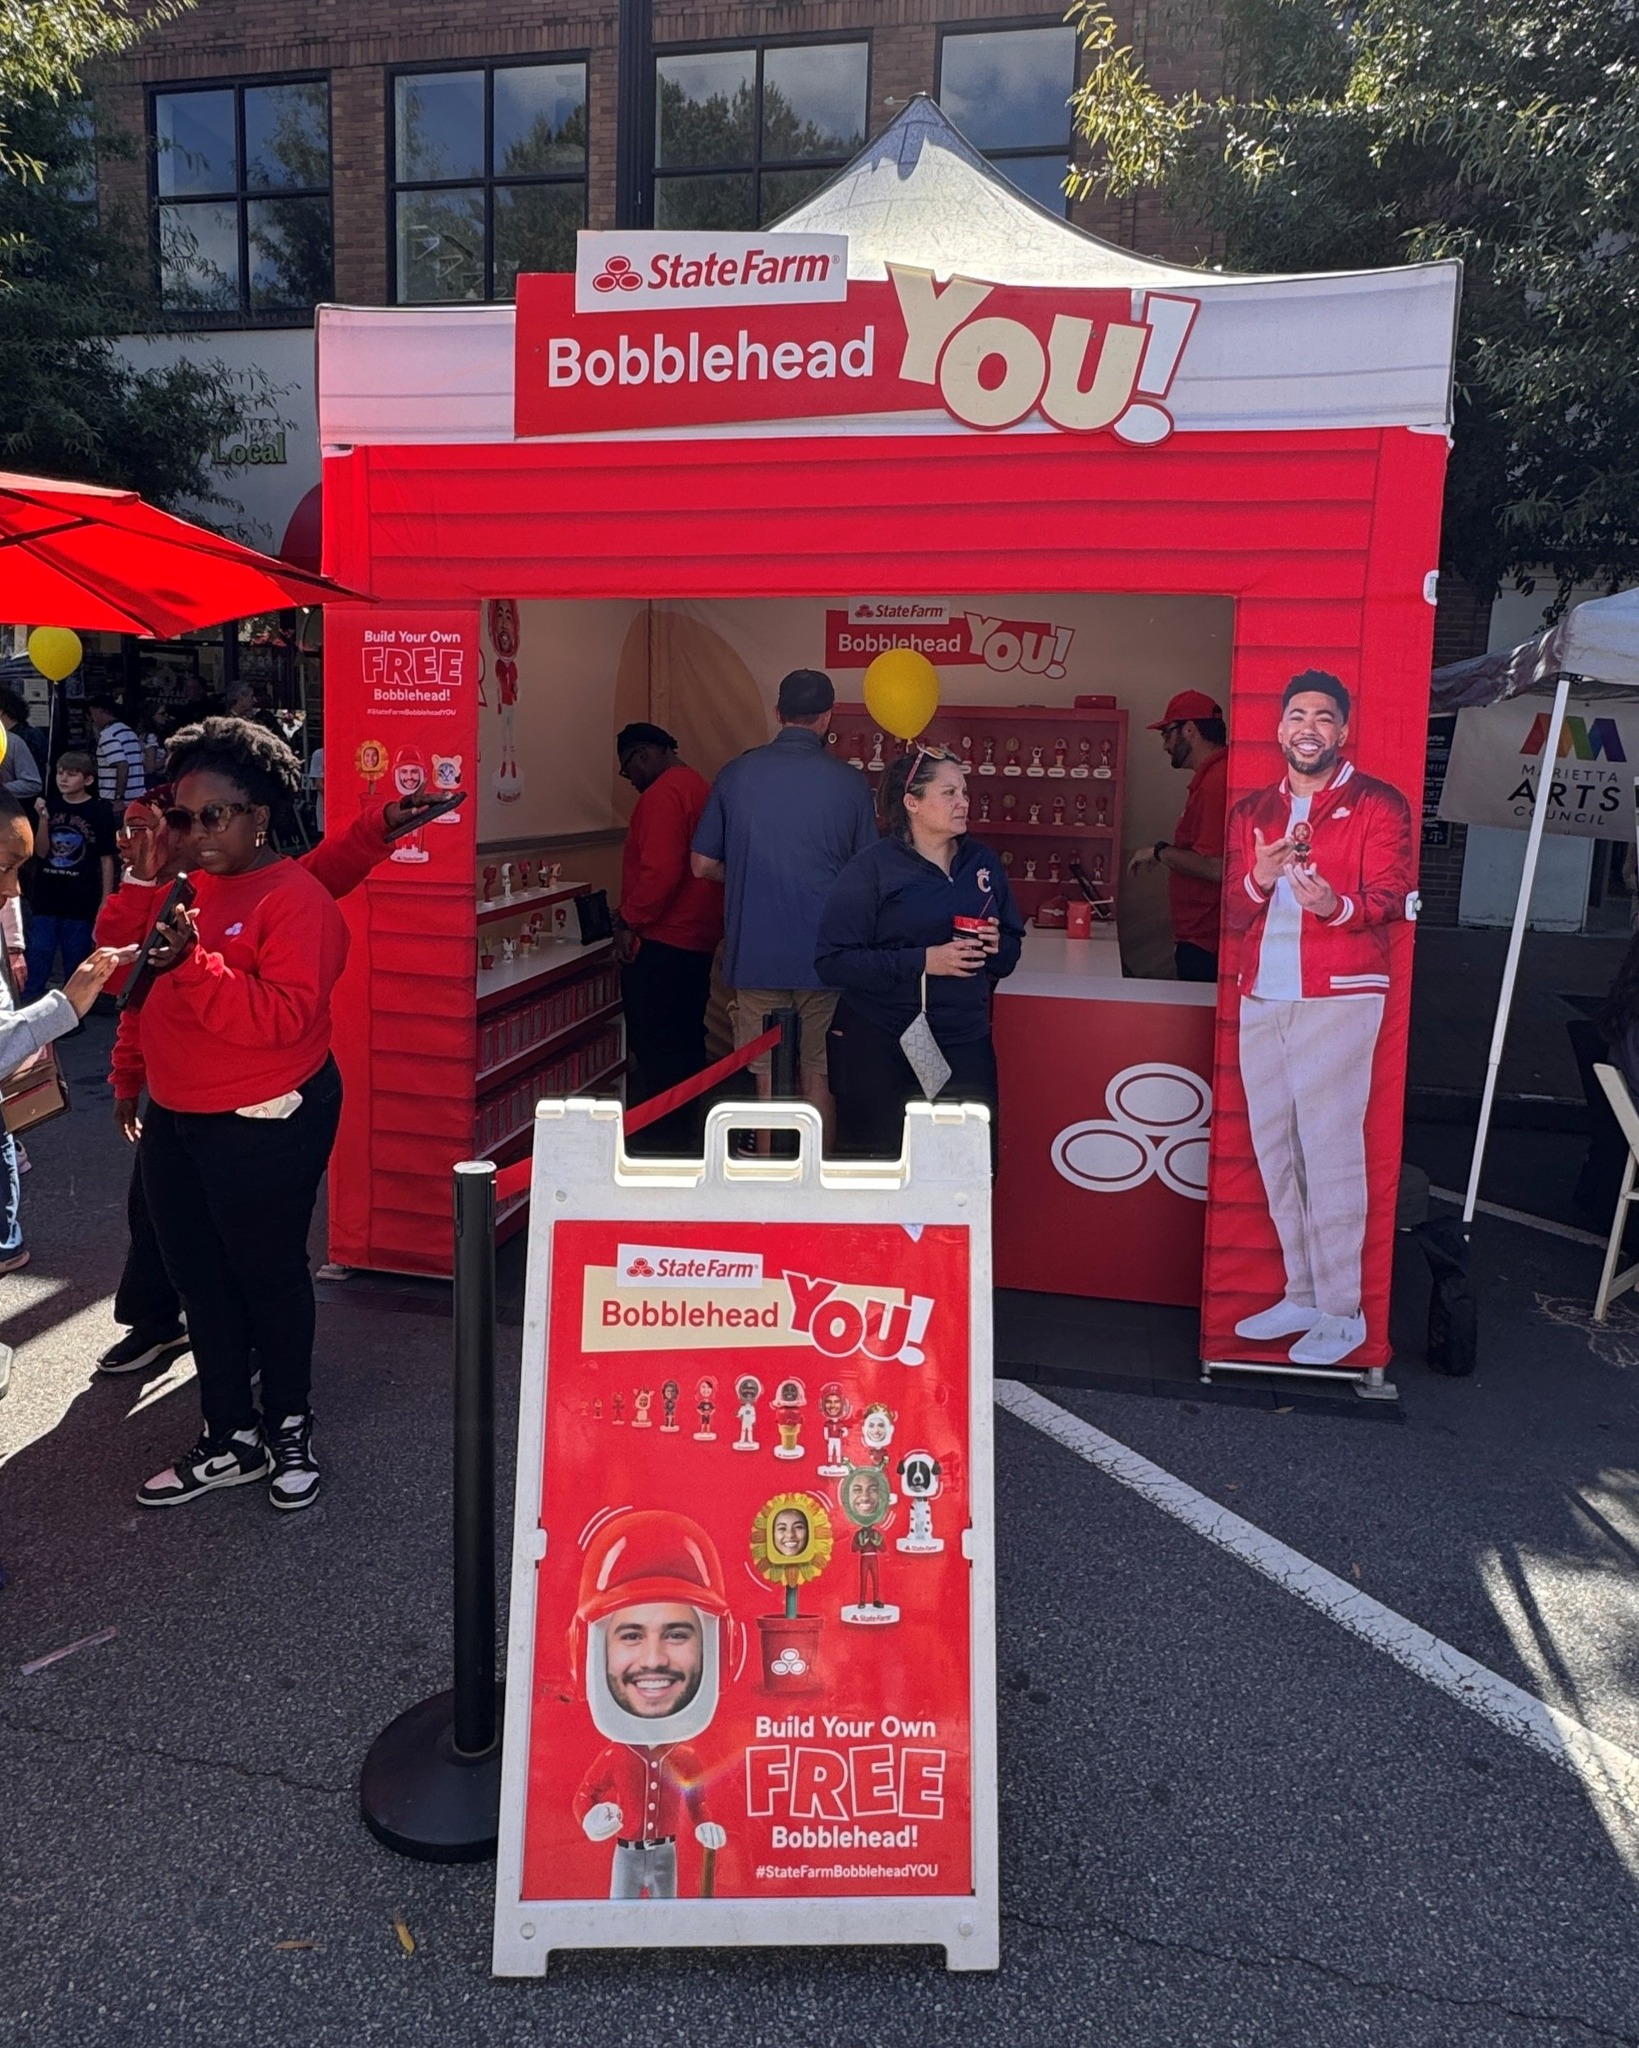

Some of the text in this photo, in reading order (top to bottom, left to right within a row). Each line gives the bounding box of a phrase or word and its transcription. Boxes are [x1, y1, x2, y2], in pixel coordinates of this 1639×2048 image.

[548, 260, 1200, 447] Bobblehead YOU!
[211, 431, 288, 465] Local
[364, 630, 461, 643] Build Your Own
[838, 611, 1076, 679] Bobblehead YOU!
[361, 646, 464, 686] FREE
[373, 688, 451, 701] Bobblehead!
[1521, 764, 1618, 782] MRIETTA
[1507, 778, 1621, 812] ARTS
[601, 1269, 935, 1367] Bobblehead YOU!
[755, 1715, 936, 1739] Build Your Own
[745, 1744, 946, 1822] FREE
[771, 1825, 918, 1848] Bobblehead!
[755, 1863, 939, 1879] #StateFarmBobbleheadYOU
